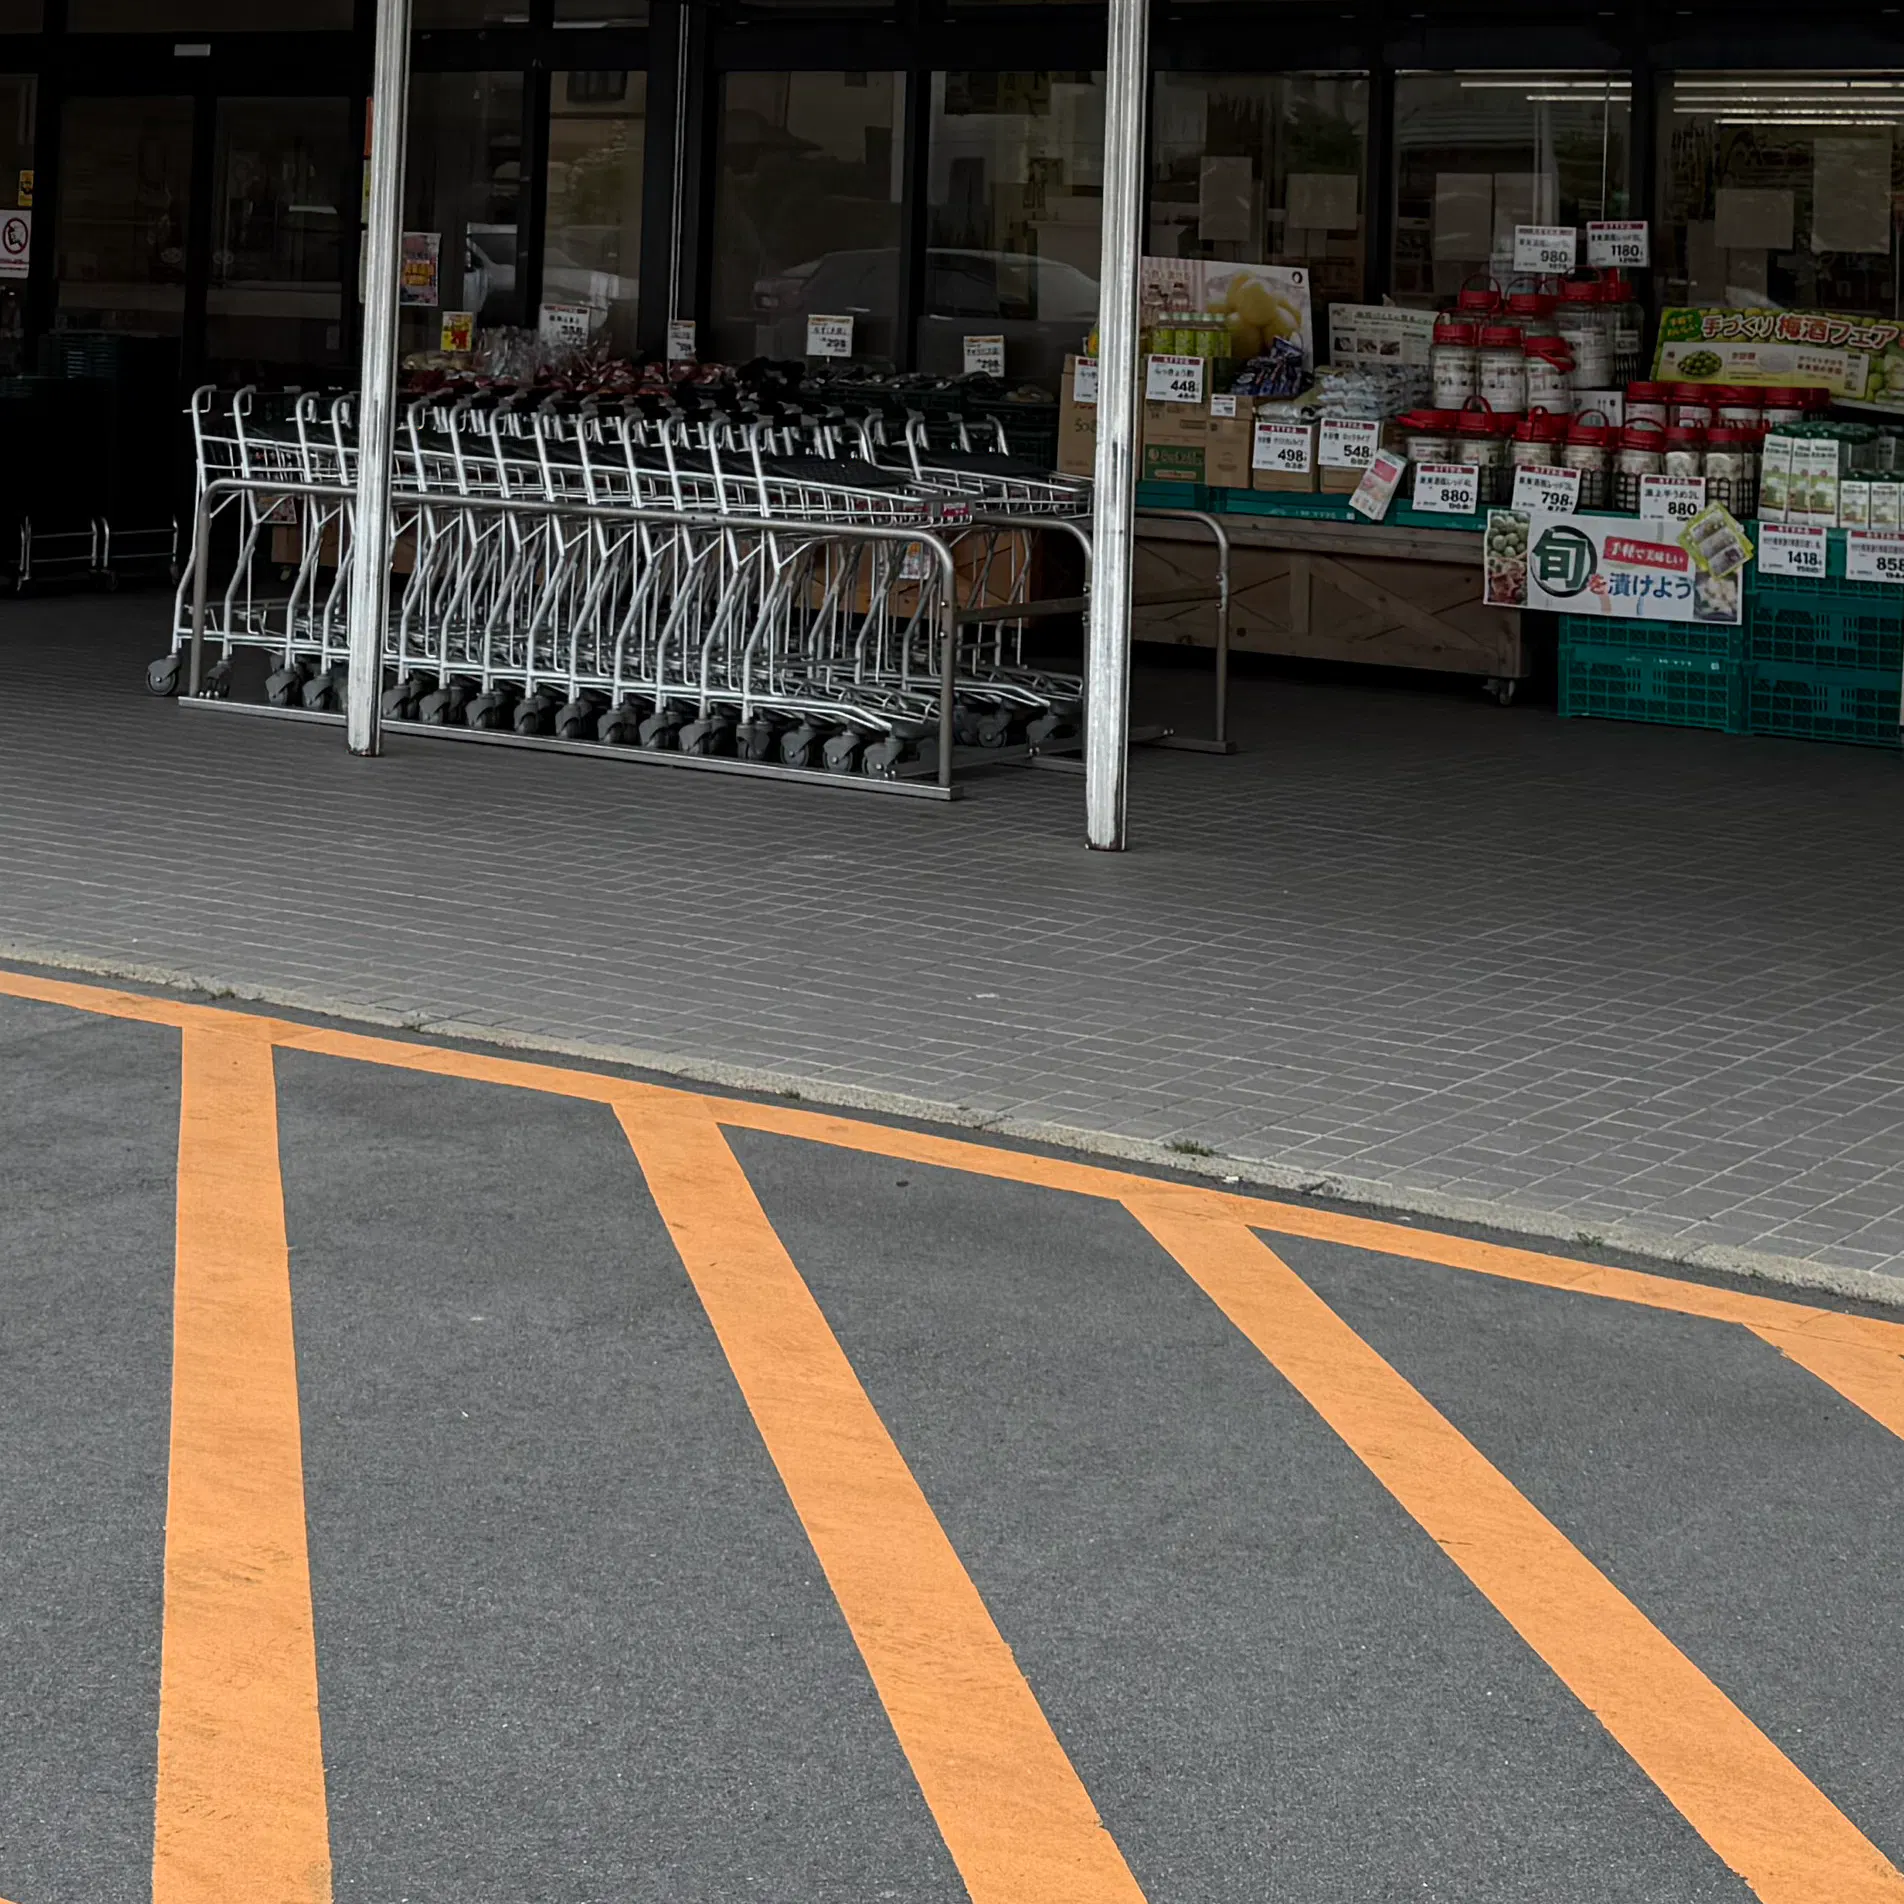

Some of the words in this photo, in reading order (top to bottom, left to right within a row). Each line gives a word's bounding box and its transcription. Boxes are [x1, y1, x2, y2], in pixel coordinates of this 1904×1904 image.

[1541, 250, 1568, 262] 980
[1611, 245, 1639, 257] 1180
[1171, 379, 1196, 392] 448
[1278, 449, 1303, 462] 498
[1344, 445, 1370, 458] 548
[1441, 489, 1469, 502] 880
[1541, 491, 1570, 506] 798
[1668, 502, 1697, 515] 880
[1788, 551, 1818, 566] 1418
